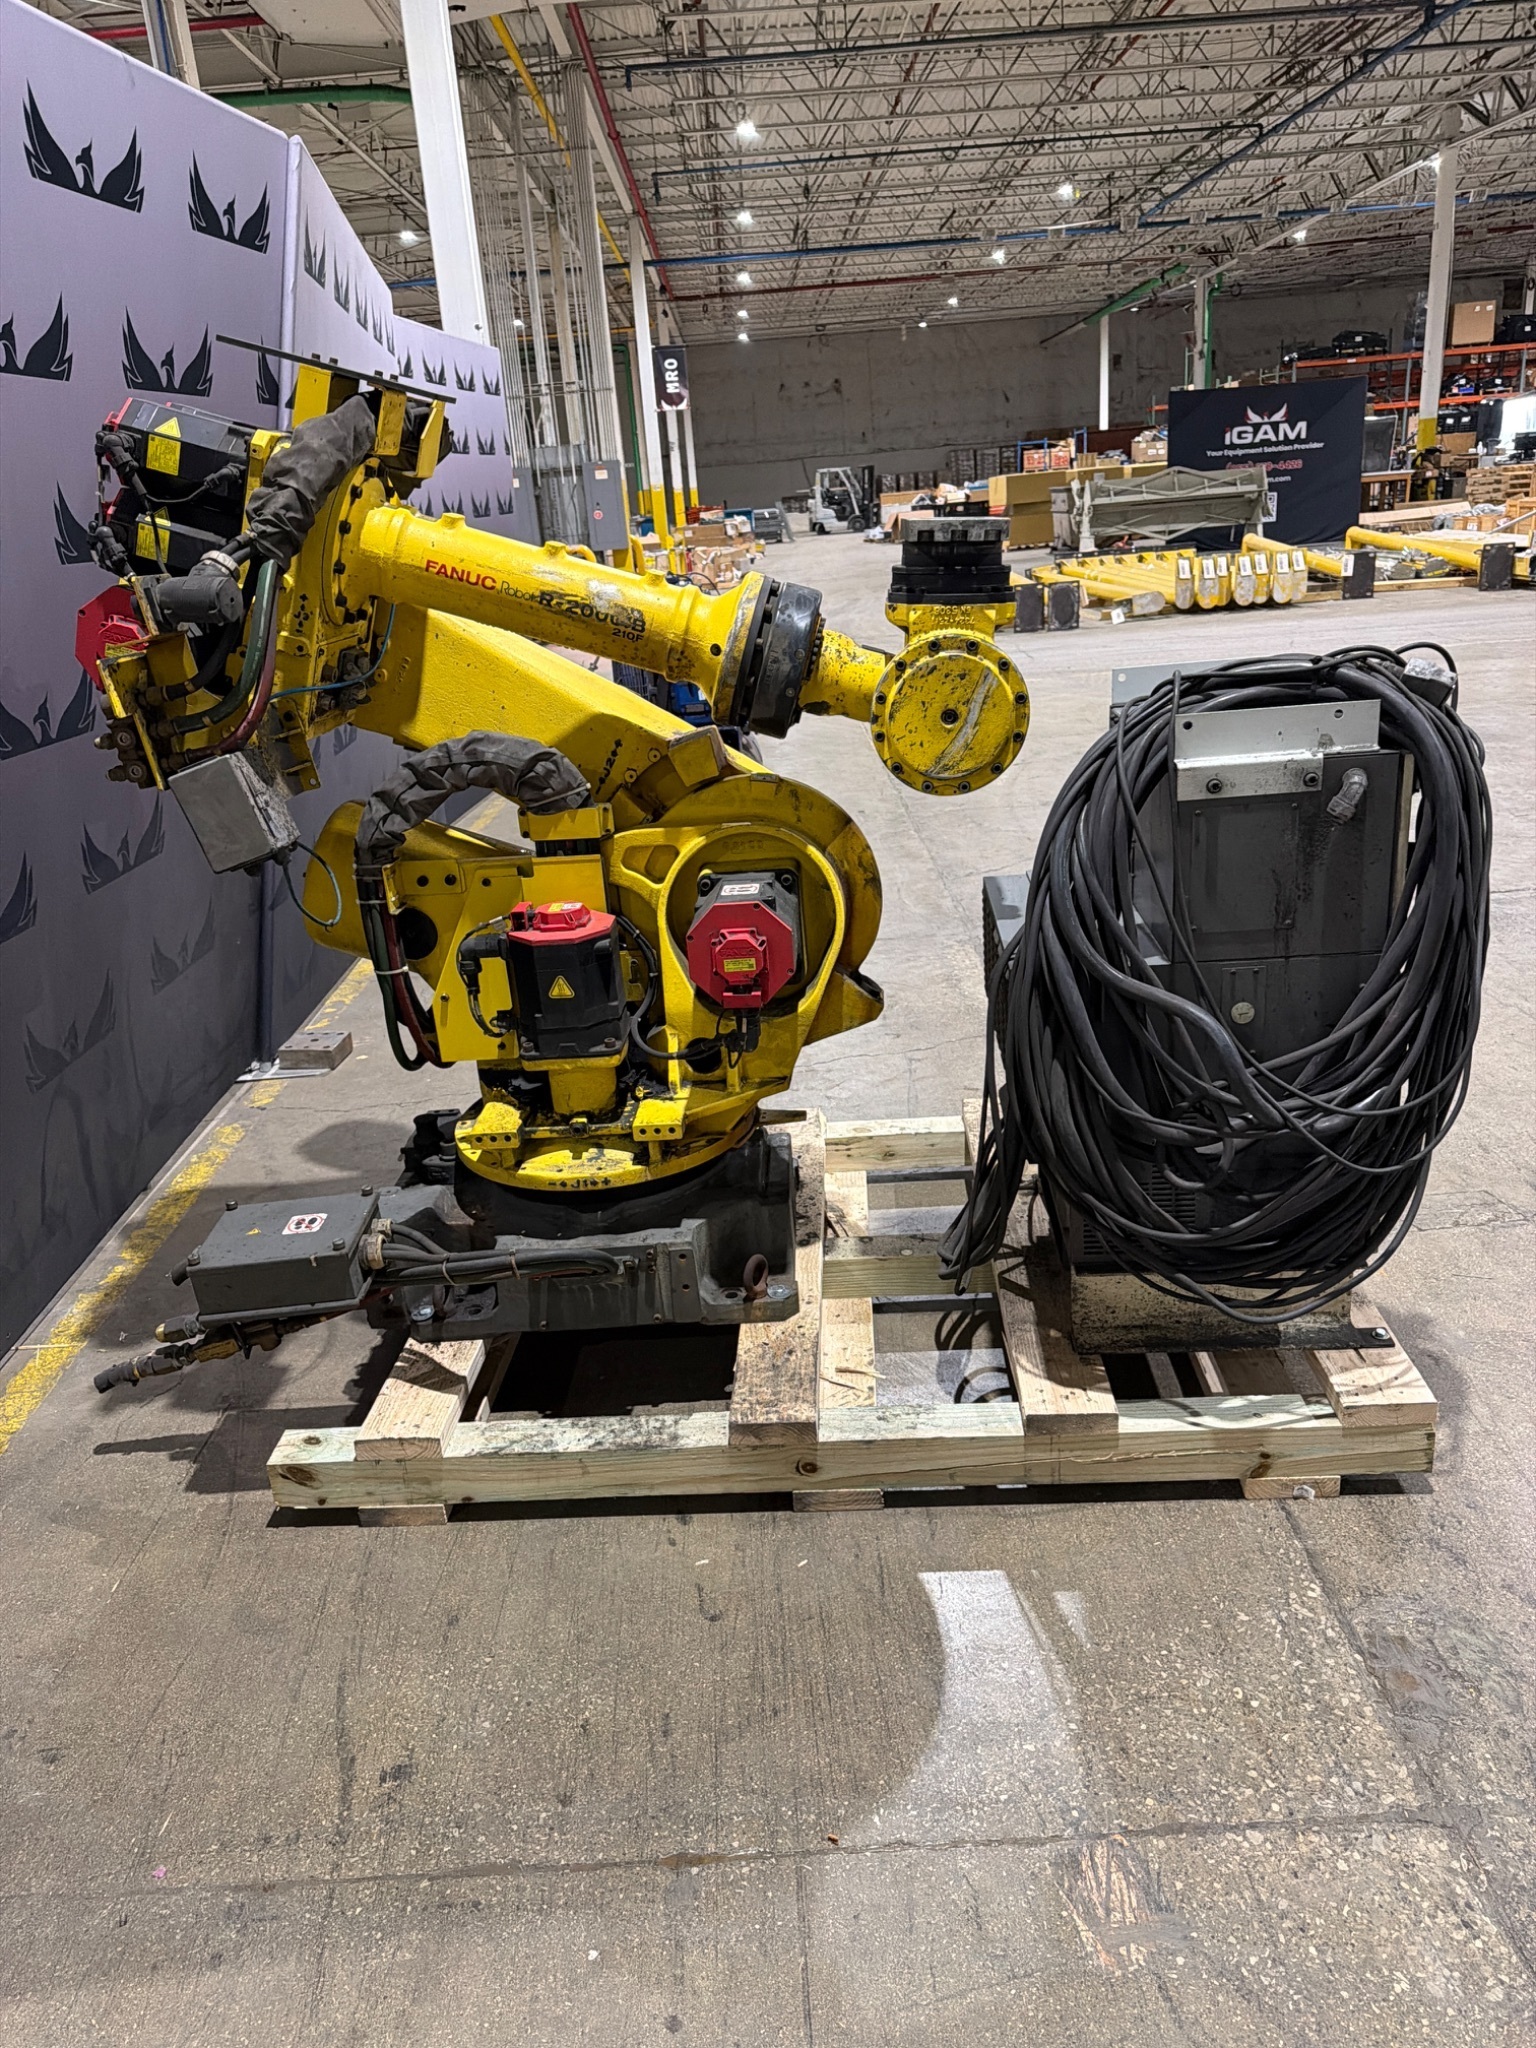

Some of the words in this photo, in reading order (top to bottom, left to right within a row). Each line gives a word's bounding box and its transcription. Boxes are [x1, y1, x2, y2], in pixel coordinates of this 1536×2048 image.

[664, 358, 680, 393] MRO
[1224, 420, 1307, 445] iGAM
[1206, 449, 1223, 457] Your
[1224, 446, 1262, 457] Equipment
[1263, 444, 1293, 453] Solution
[1293, 442, 1324, 450] Provider
[424, 559, 497, 590] FANUC
[612, 627, 645, 643] 210F
